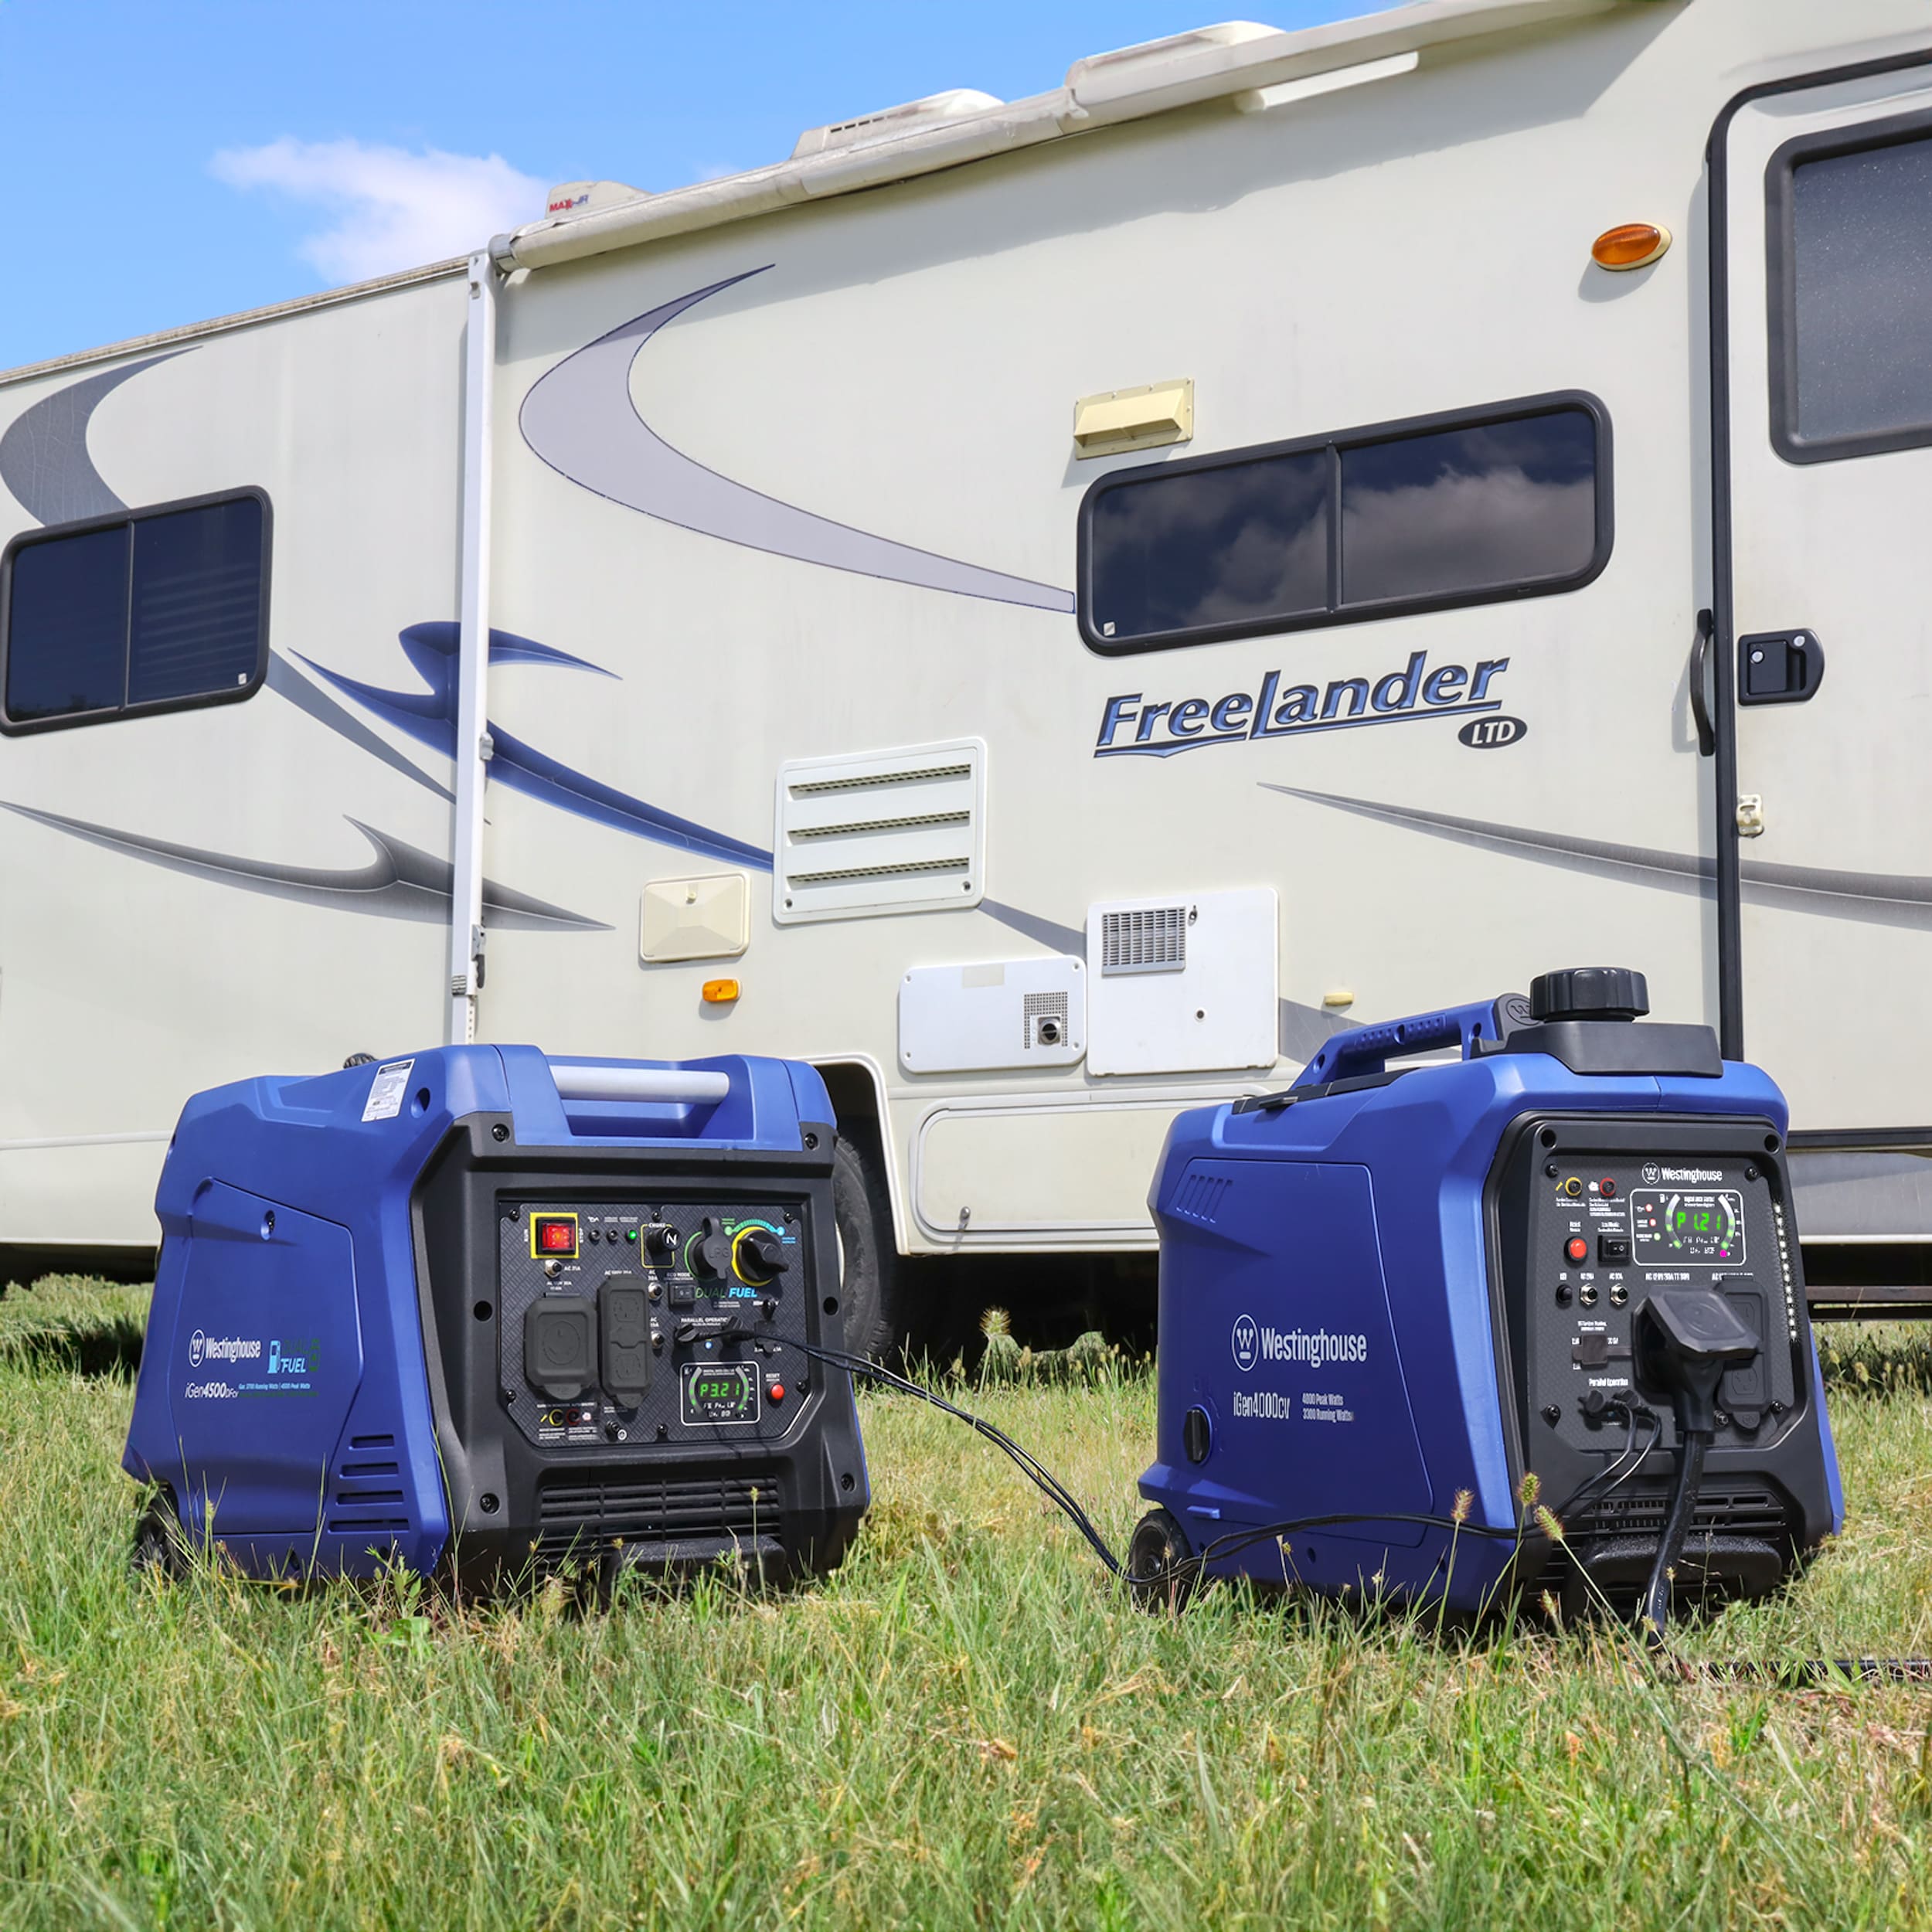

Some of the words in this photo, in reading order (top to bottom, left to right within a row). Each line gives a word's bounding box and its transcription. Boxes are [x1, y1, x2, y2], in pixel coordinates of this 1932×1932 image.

[1096, 650, 1511, 746] Freelander
[1470, 720, 1517, 744] LTD
[1661, 1167, 1723, 1183] Westinghouse
[695, 1287, 726, 1298] DUAL
[728, 1287, 758, 1298] FUEL
[206, 1336, 261, 1363] Westinghouse
[1260, 1328, 1367, 1368] Westinghouse
[281, 1358, 307, 1373] FUEL
[1315, 1393, 1328, 1406] Peak
[1328, 1393, 1343, 1406] Watts
[1316, 1408, 1336, 1423] Running
[1336, 1409, 1354, 1422] Watts
